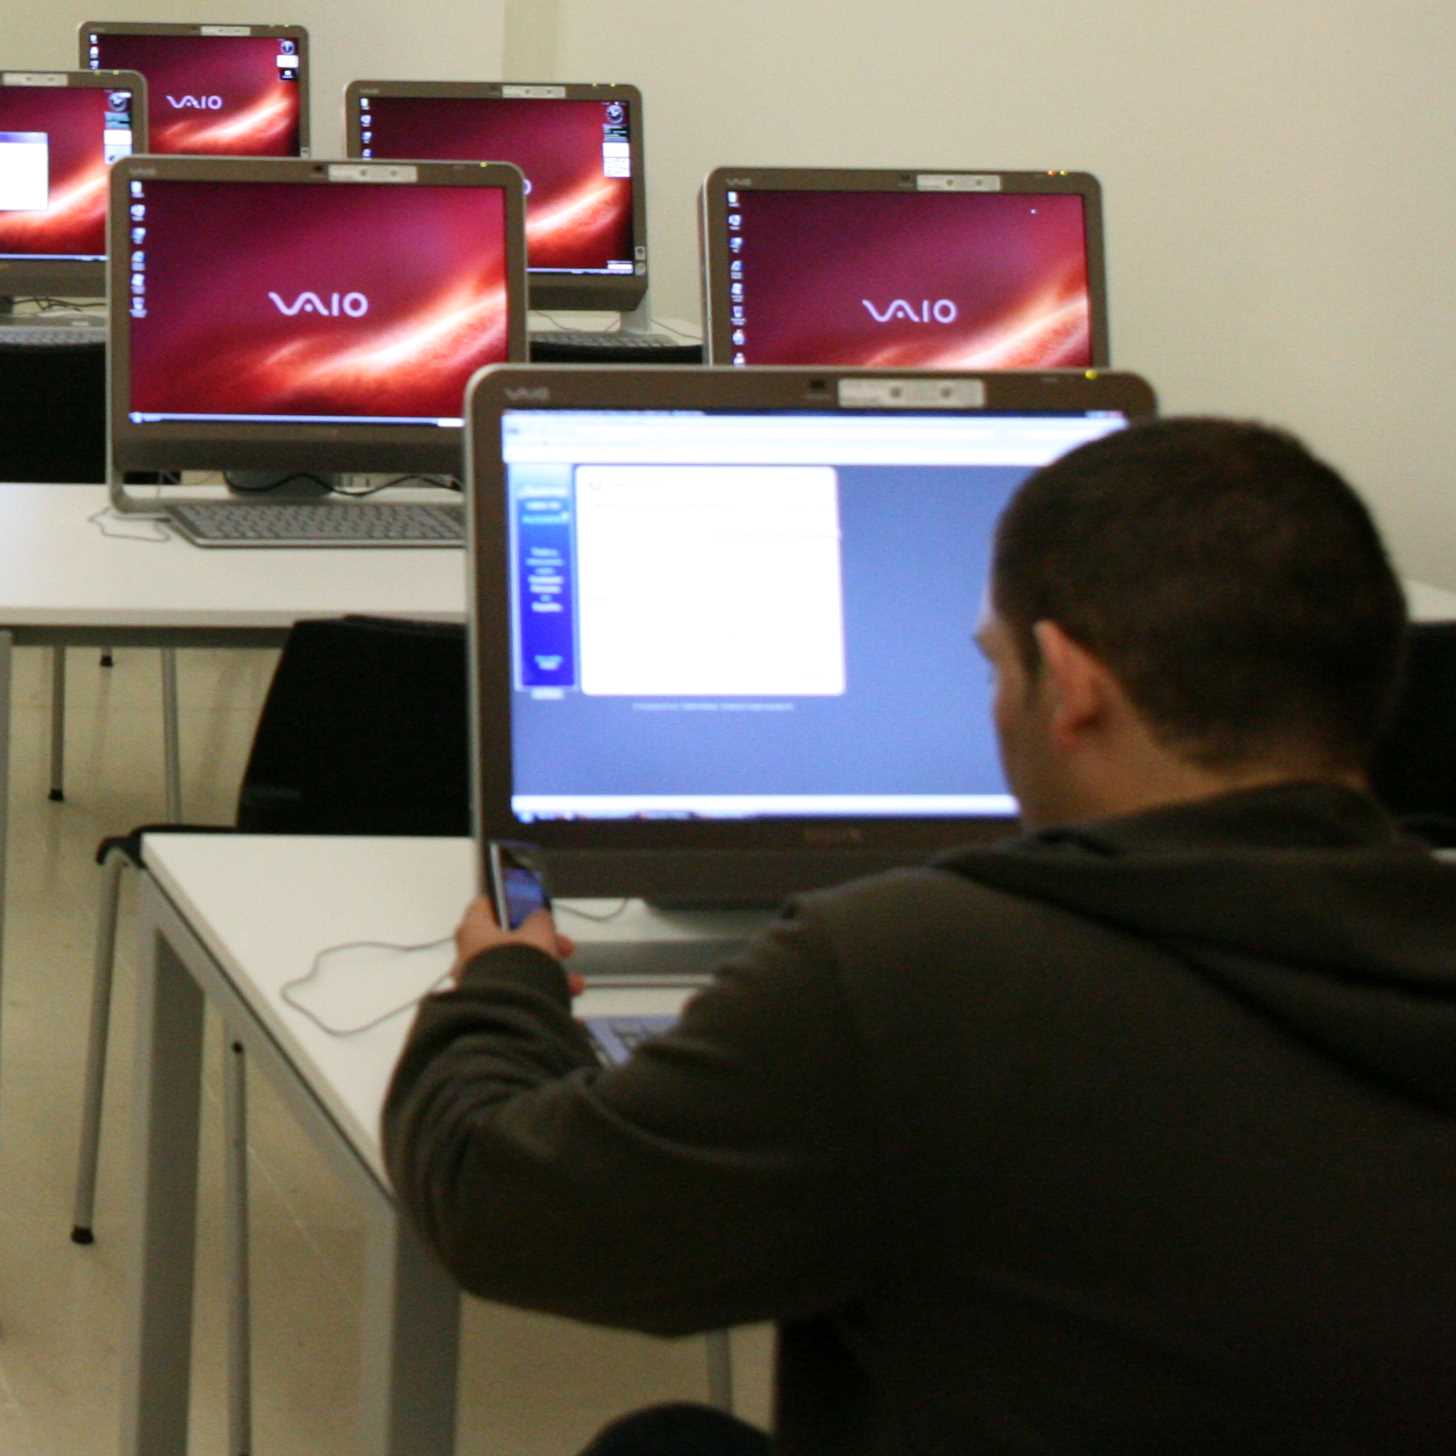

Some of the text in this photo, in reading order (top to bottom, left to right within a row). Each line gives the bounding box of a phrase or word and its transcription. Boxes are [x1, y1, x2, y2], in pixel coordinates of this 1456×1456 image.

[166, 95, 223, 110] VAIO
[268, 291, 369, 318] VAIO
[861, 299, 958, 324] VAIO
